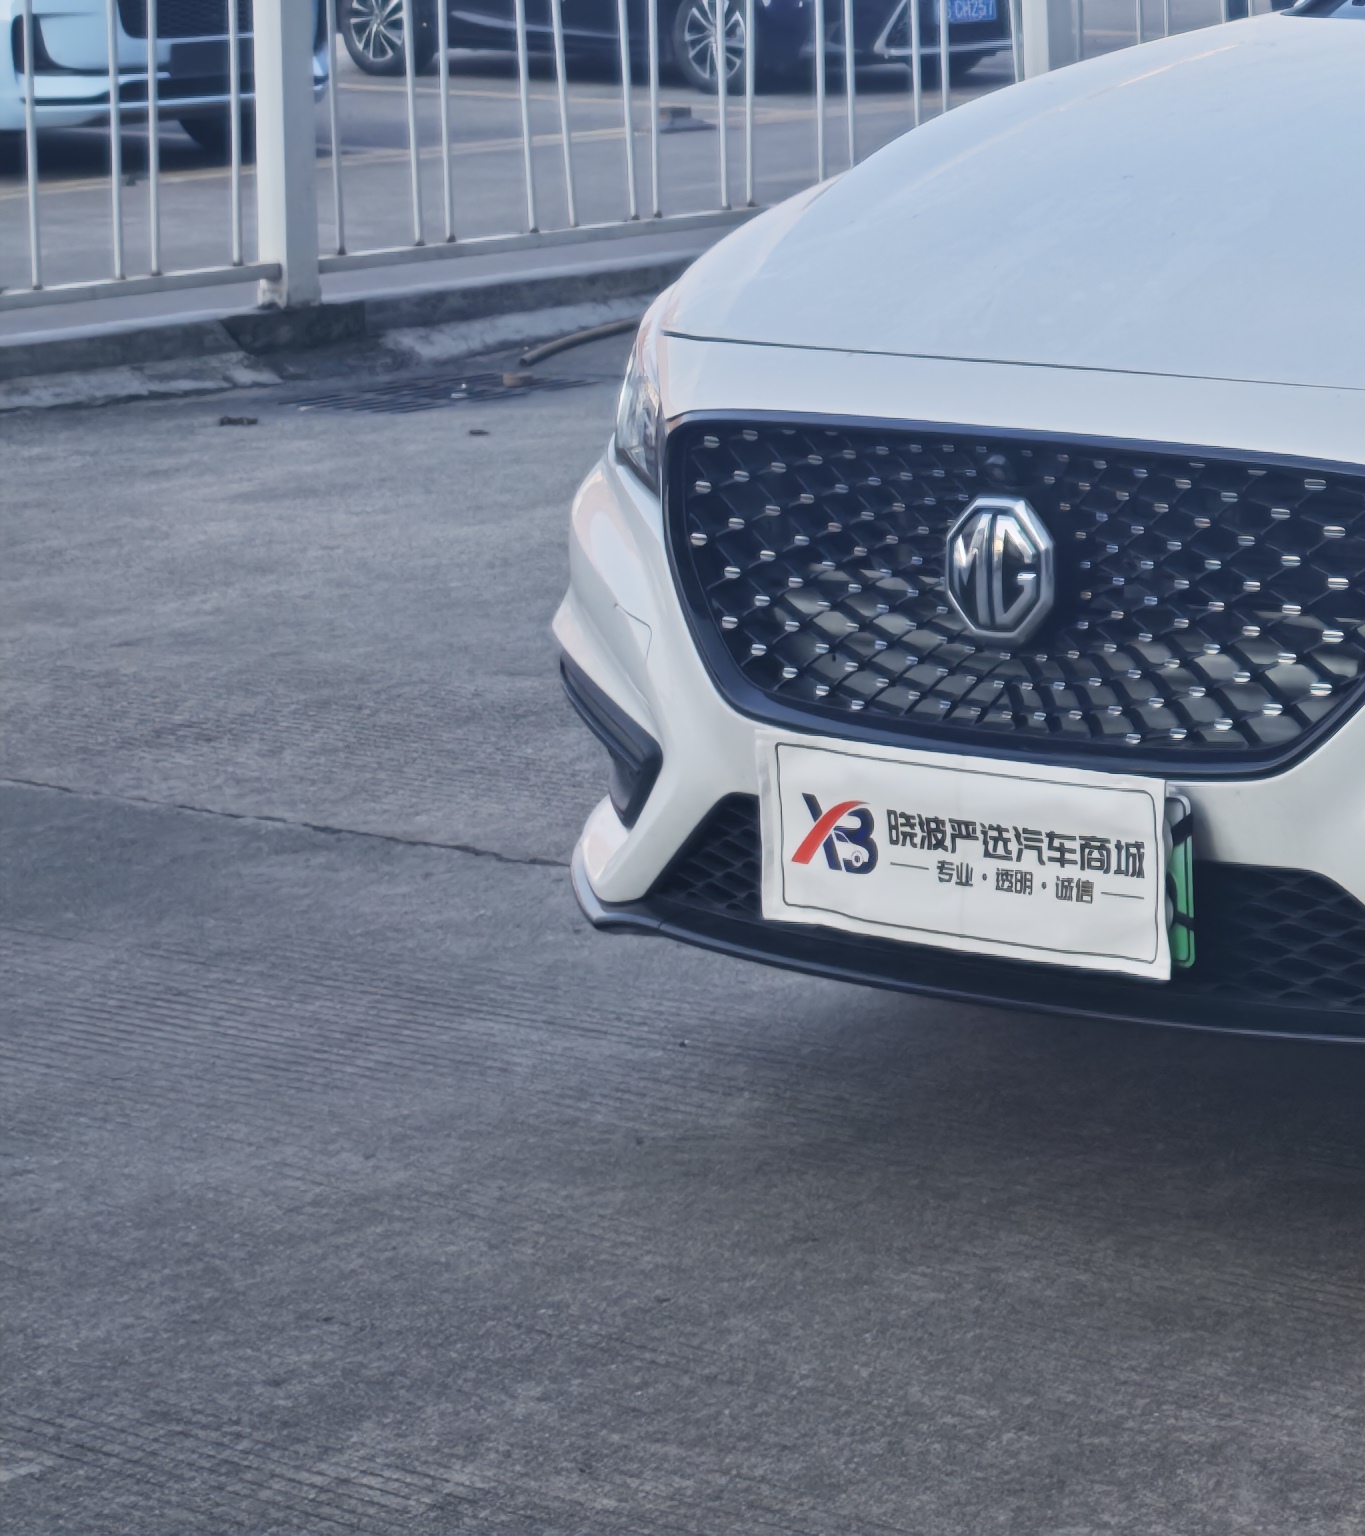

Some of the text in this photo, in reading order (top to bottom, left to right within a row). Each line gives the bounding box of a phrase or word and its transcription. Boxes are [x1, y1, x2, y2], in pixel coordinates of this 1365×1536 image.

[953, 513, 1037, 627] MG
[886, 809, 1146, 879] 晓波严选汽车商城
